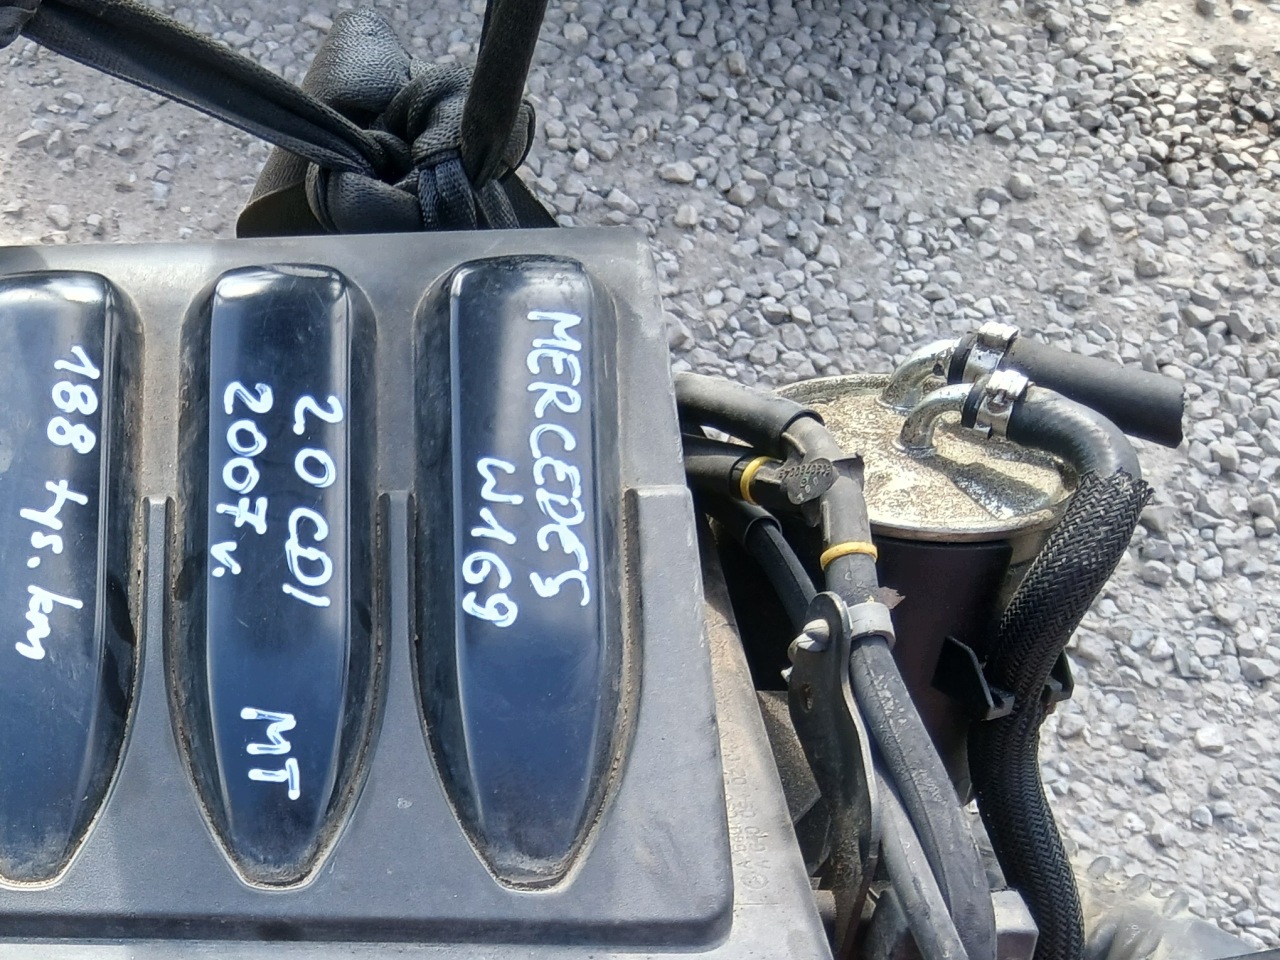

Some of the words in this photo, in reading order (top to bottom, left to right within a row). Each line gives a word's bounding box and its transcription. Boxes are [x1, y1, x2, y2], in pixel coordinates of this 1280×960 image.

[46, 345, 101, 454] 188
[215, 381, 274, 535] 2007
[526, 310, 591, 607] MERCEDES
[19, 479, 88, 569] tys.
[282, 507, 333, 607] CDI
[462, 457, 524, 628] W169
[15, 584, 84, 660] km
[240, 707, 301, 801] MT
